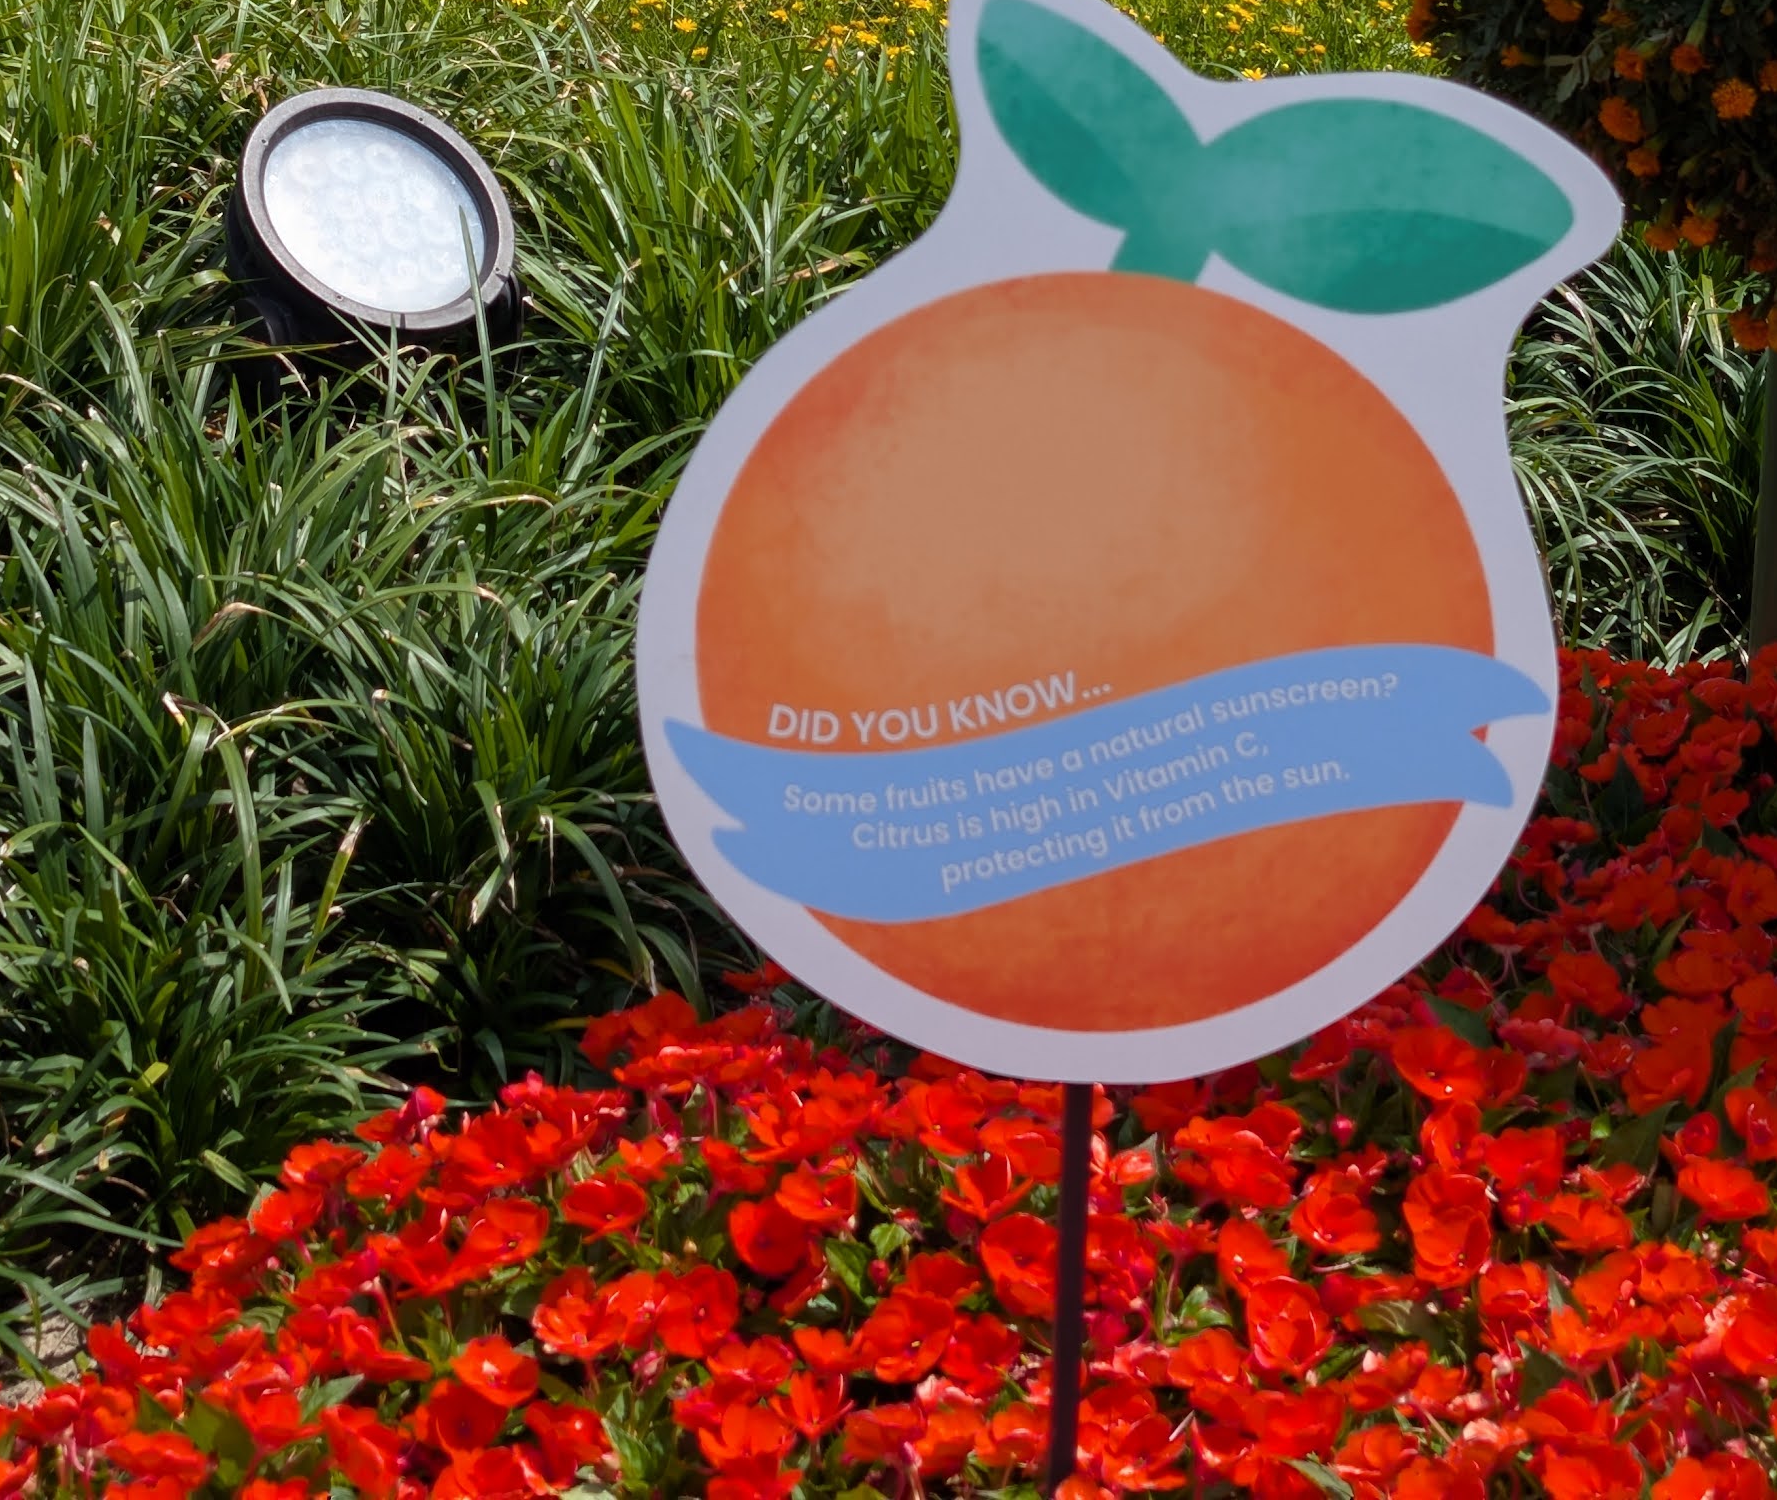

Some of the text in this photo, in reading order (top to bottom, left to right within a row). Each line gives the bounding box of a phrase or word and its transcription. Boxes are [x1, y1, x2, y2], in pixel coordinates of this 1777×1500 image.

[767, 702, 840, 744] DID
[851, 703, 939, 745] YOU
[783, 672, 1399, 815] Some fruits have a natural sunscreen?
[851, 731, 1270, 850] Citrus is high in Vitamin C,
[940, 760, 1351, 894] protecting it from the sun.
